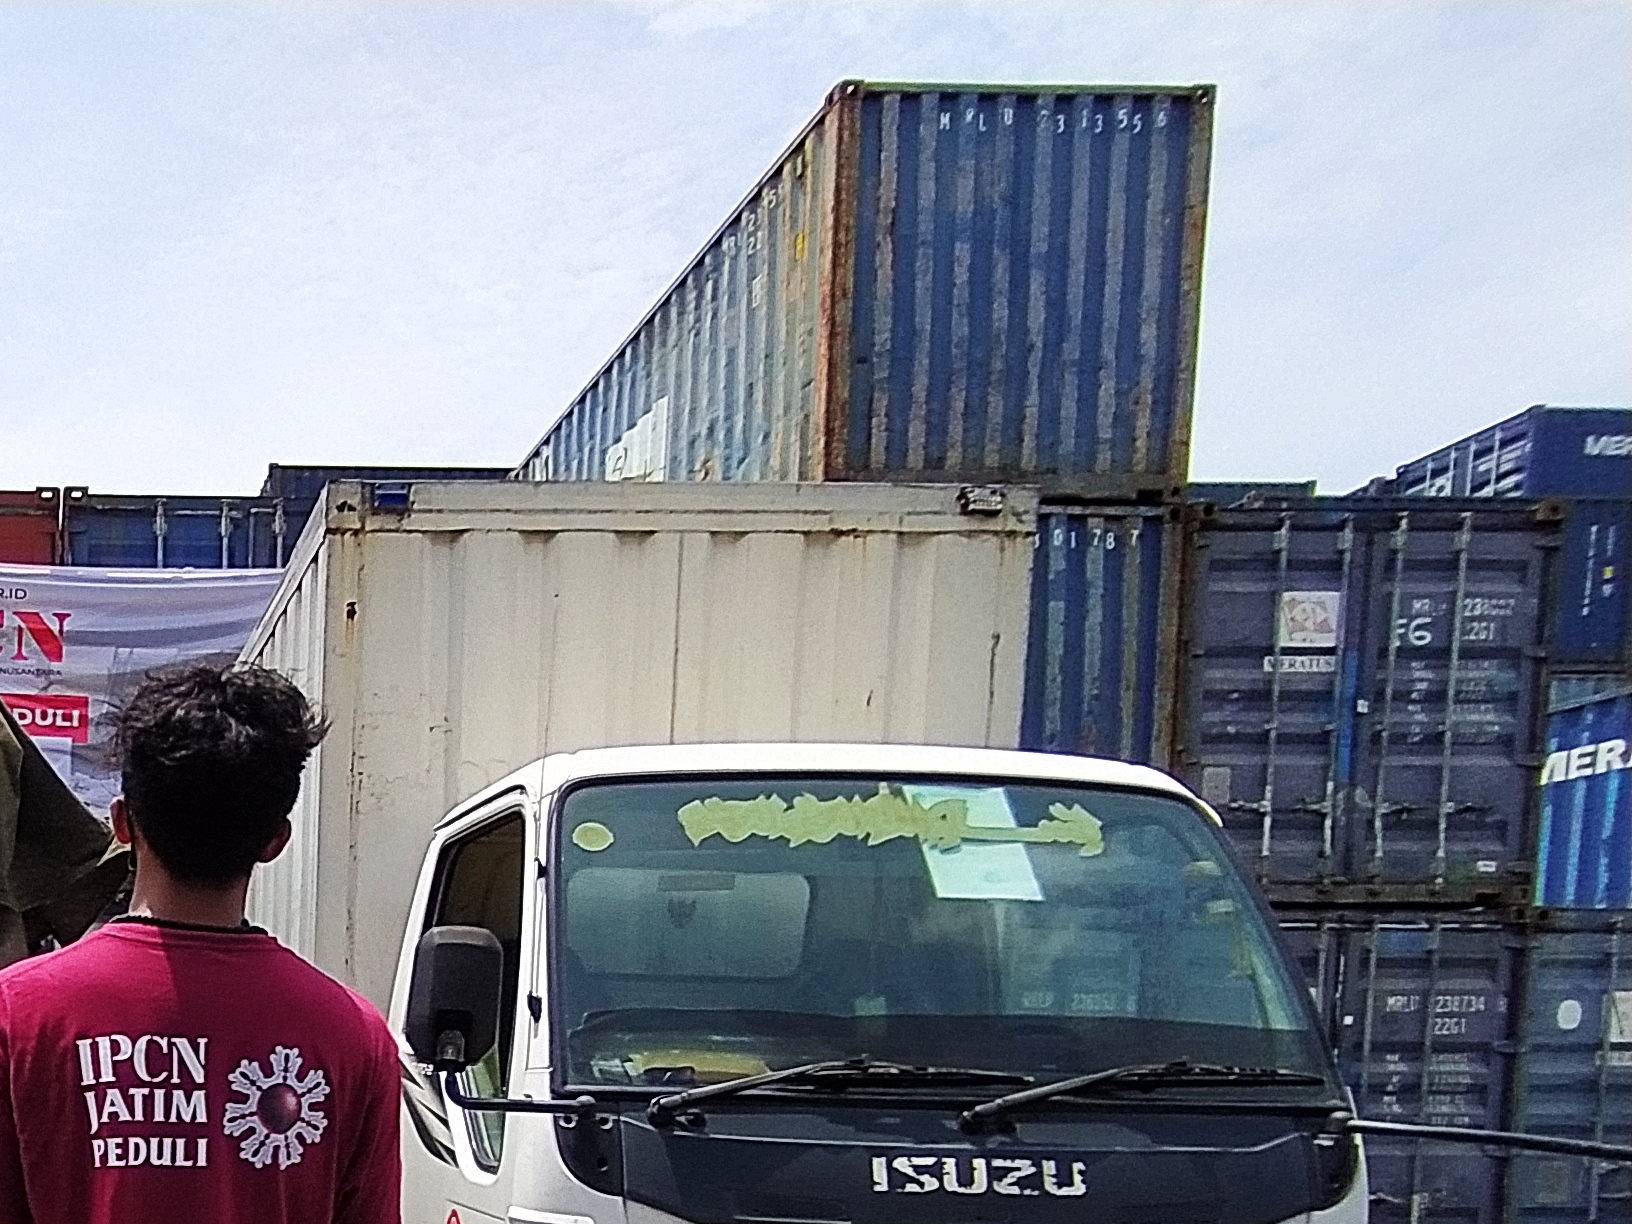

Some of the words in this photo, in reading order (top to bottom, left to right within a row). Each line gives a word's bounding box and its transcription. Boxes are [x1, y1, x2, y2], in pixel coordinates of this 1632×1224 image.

[0, 666, 63, 677] NUSANTARA
[76, 1034, 208, 1086] IPCN
[83, 1087, 208, 1135] JATIM
[91, 1136, 208, 1168] PEDULI
[871, 1156, 1087, 1196] ISUZU
